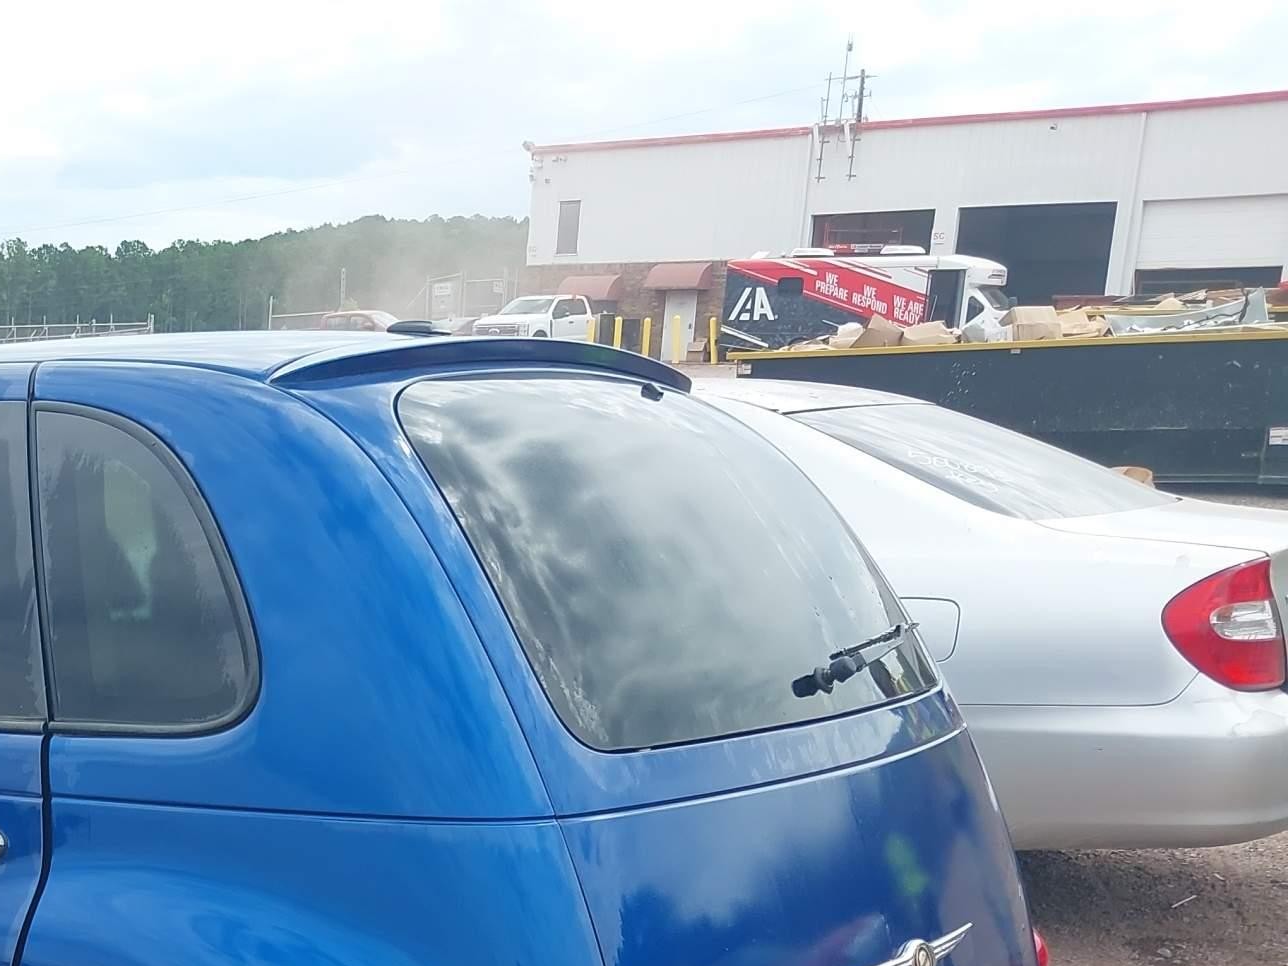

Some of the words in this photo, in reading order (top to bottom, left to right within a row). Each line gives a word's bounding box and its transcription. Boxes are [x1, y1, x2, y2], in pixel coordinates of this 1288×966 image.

[825, 271, 839, 286] WE
[815, 279, 849, 301] PREPARE
[863, 284, 878, 298] WE
[852, 292, 888, 314] RESPOND
[893, 294, 907, 310] WE
[907, 299, 924, 315] ARE
[893, 307, 921, 325] READY
